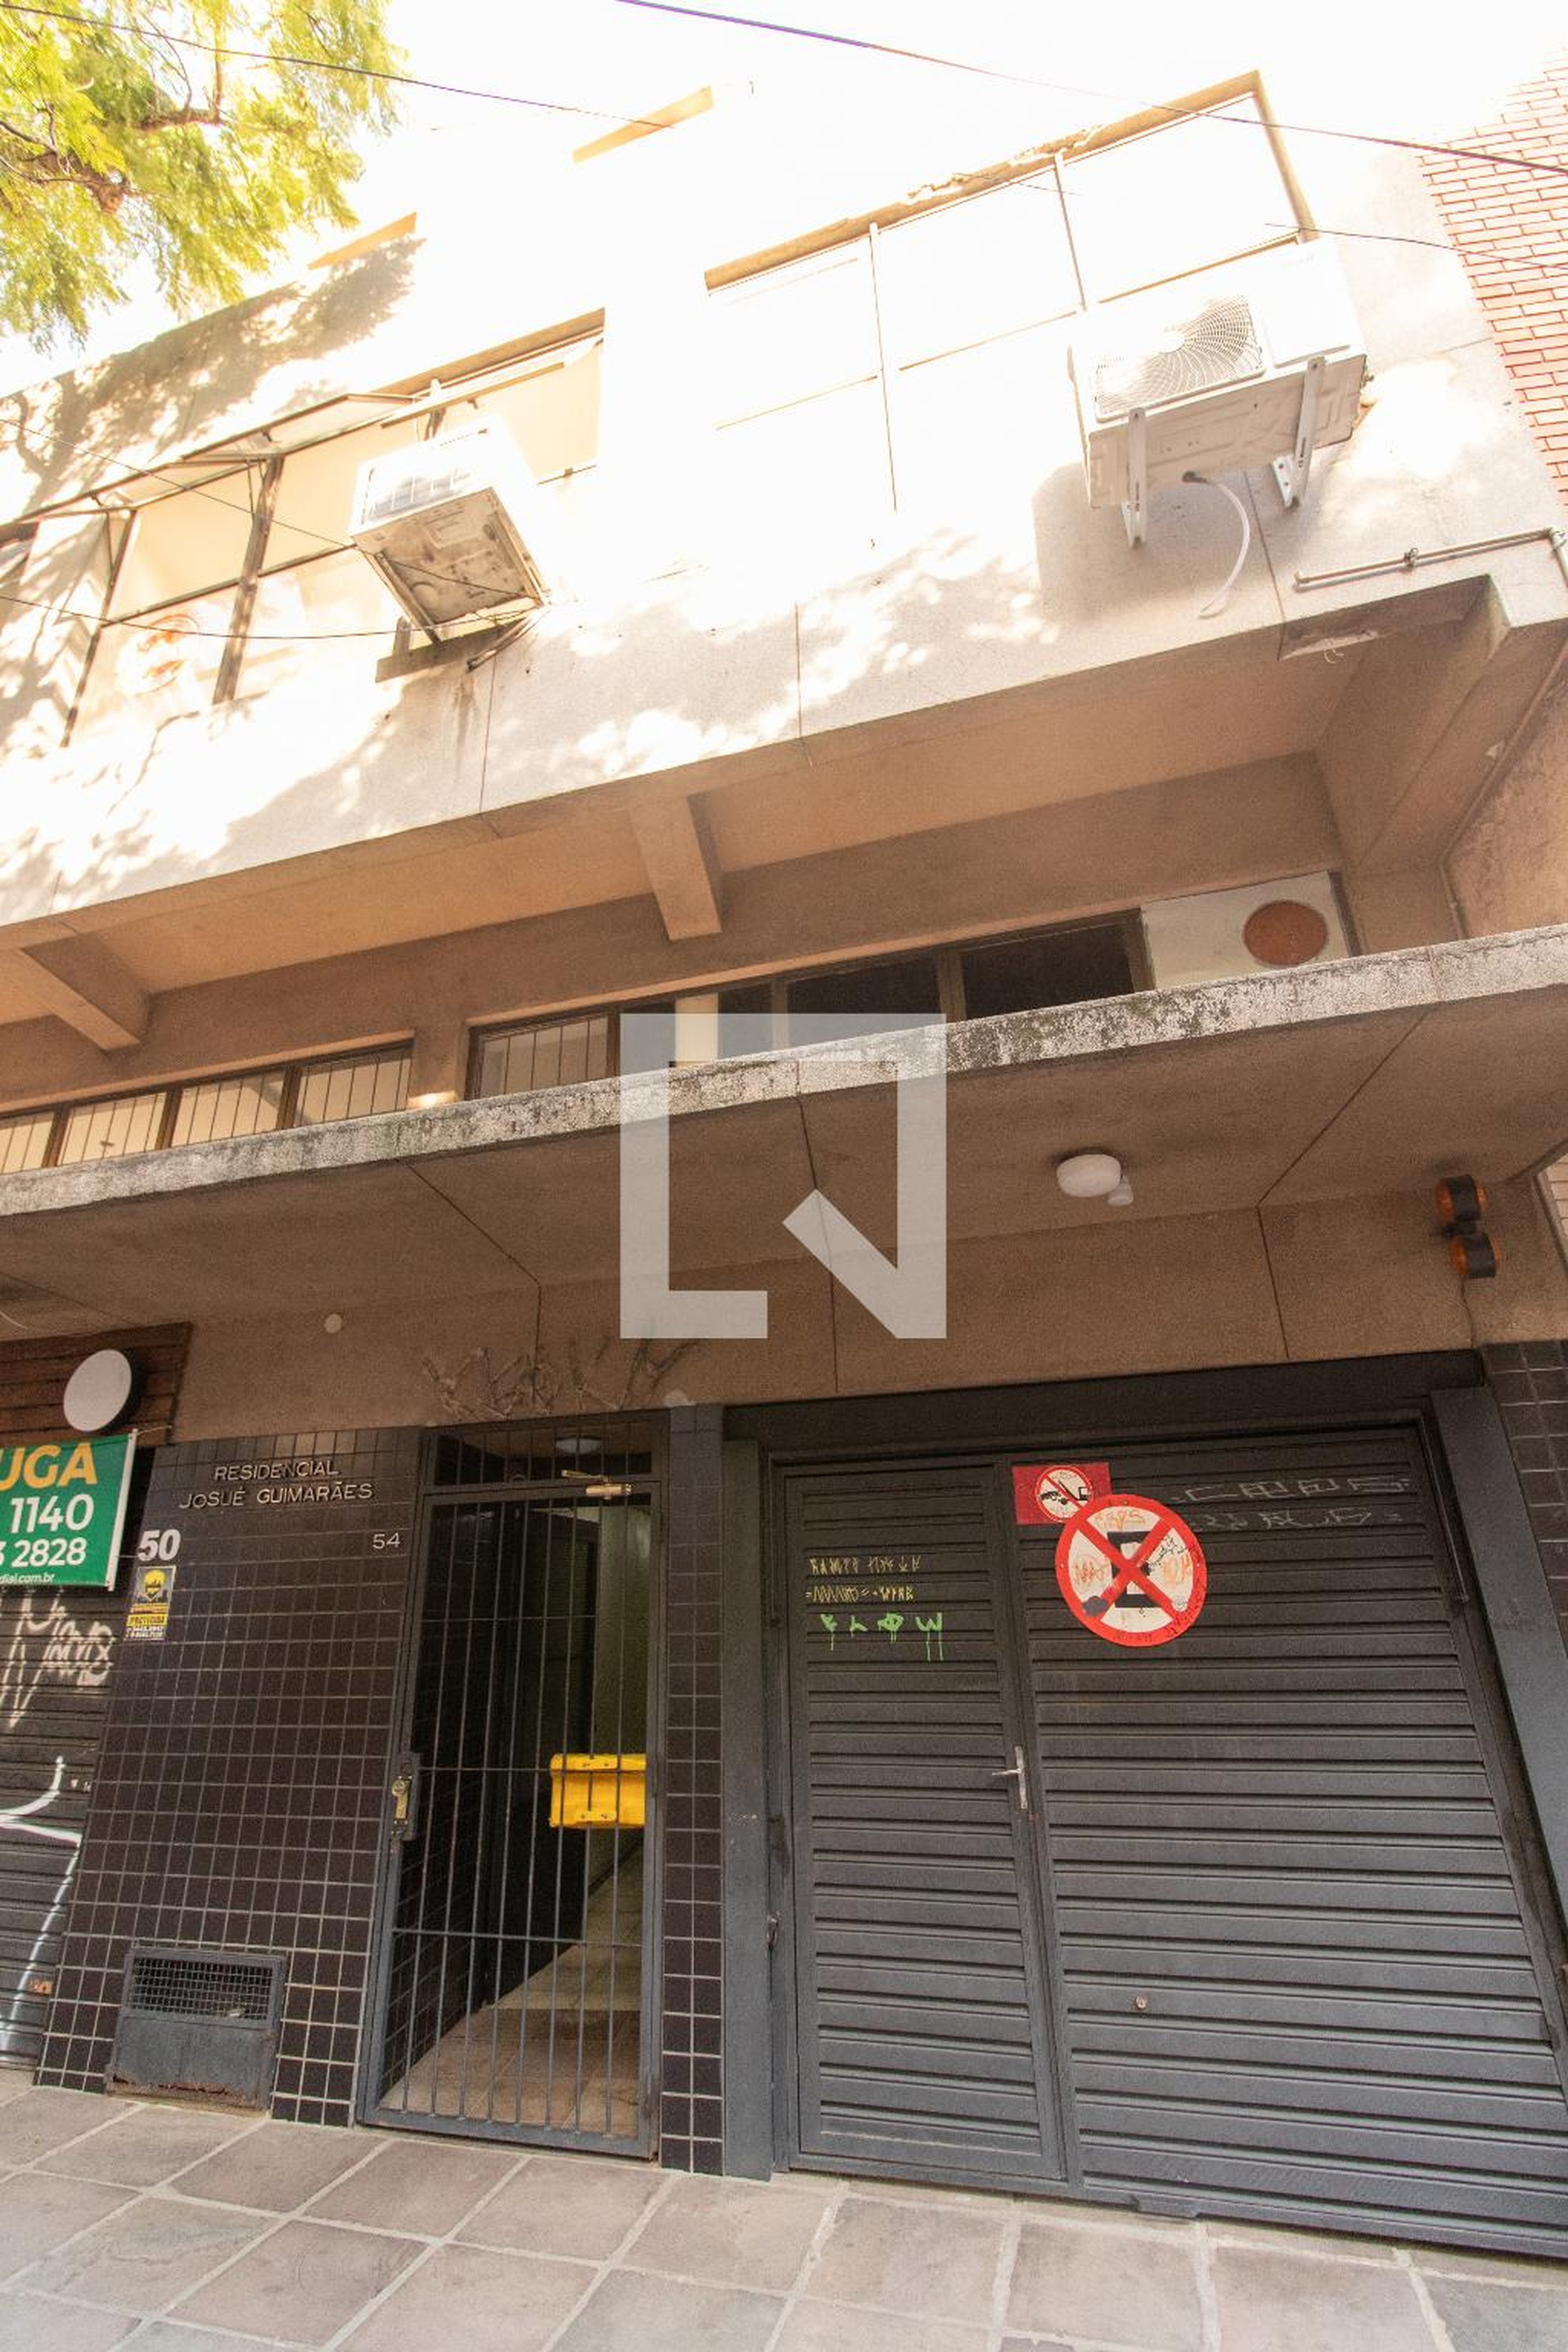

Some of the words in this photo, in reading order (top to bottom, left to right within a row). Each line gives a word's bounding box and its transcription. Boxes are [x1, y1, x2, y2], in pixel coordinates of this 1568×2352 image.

[214, 1461, 340, 1481] RESIDENCIAL
[180, 1486, 245, 1509] JOSUÉ
[256, 1481, 373, 1503] GUIMARÃES
[11, 1494, 94, 1534] 1140
[11, 1537, 87, 1567] 2828
[138, 1529, 181, 1561] 50
[372, 1532, 401, 1550] 54
